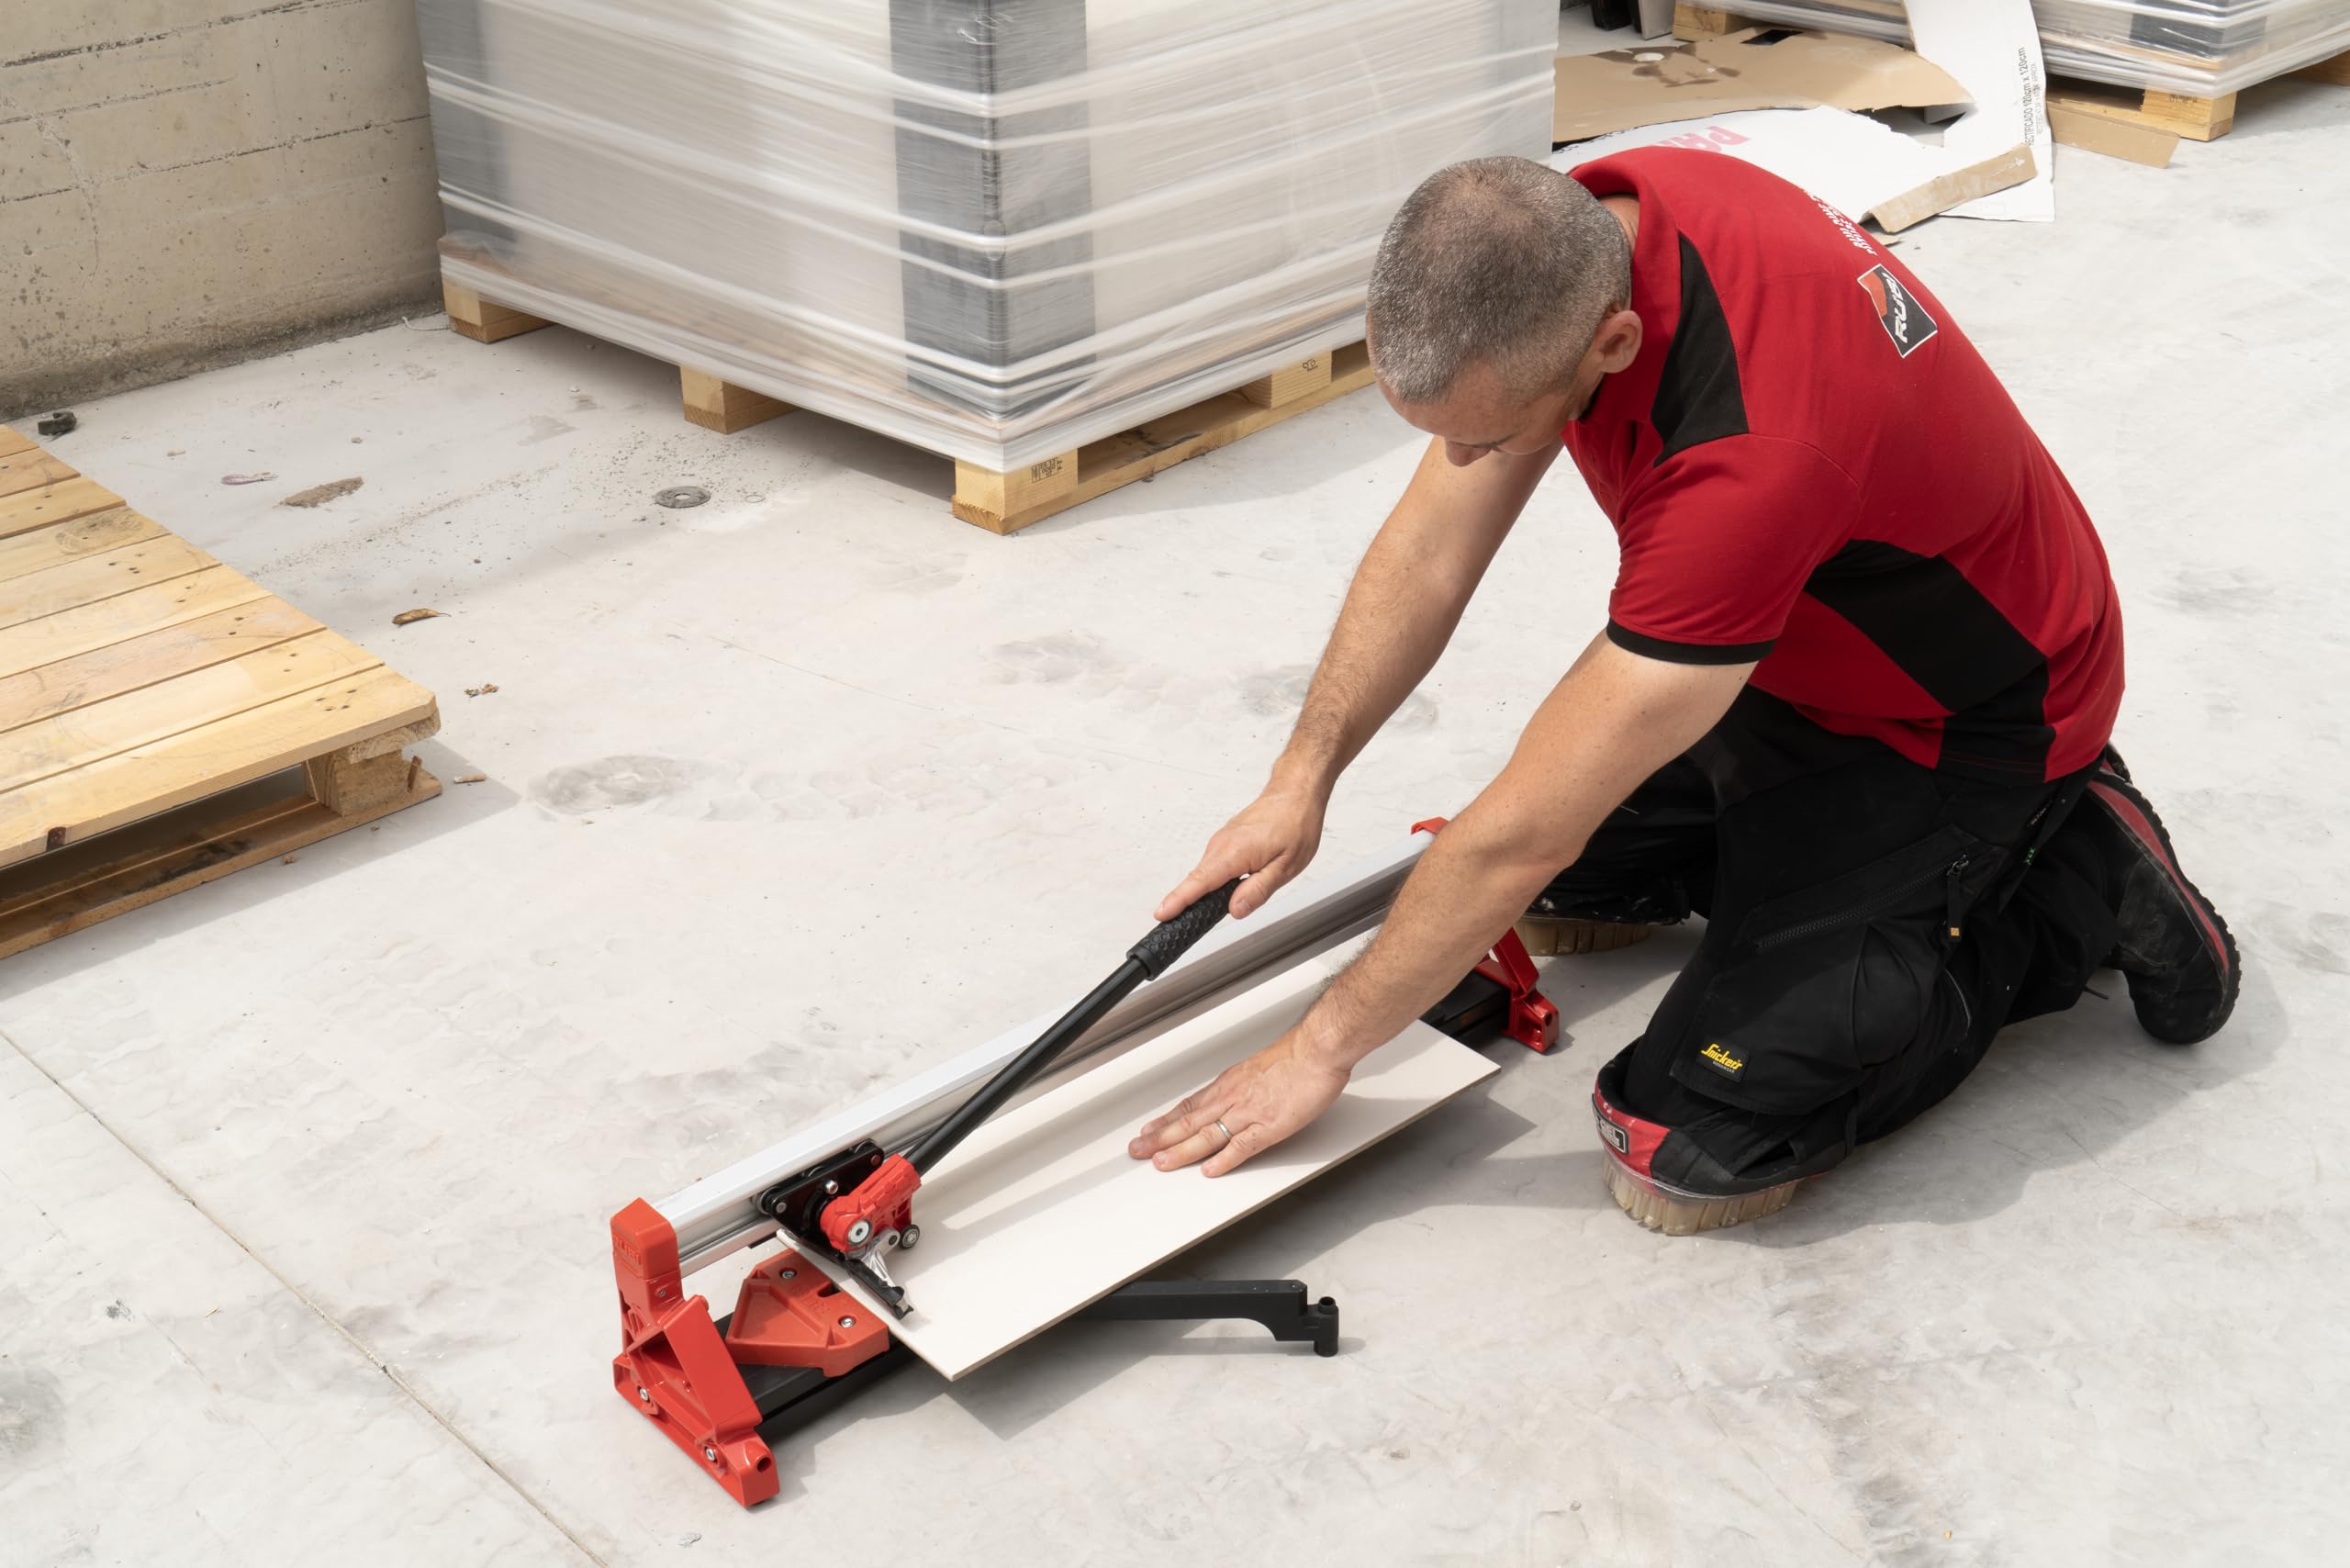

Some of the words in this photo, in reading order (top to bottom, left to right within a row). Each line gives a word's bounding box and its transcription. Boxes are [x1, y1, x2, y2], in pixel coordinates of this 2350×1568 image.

[2018, 47, 2029, 75] 120cm
[2022, 83, 2032, 107] 120cm
[1655, 125, 1750, 153] PA
[1881, 272, 1908, 343] RUBI
